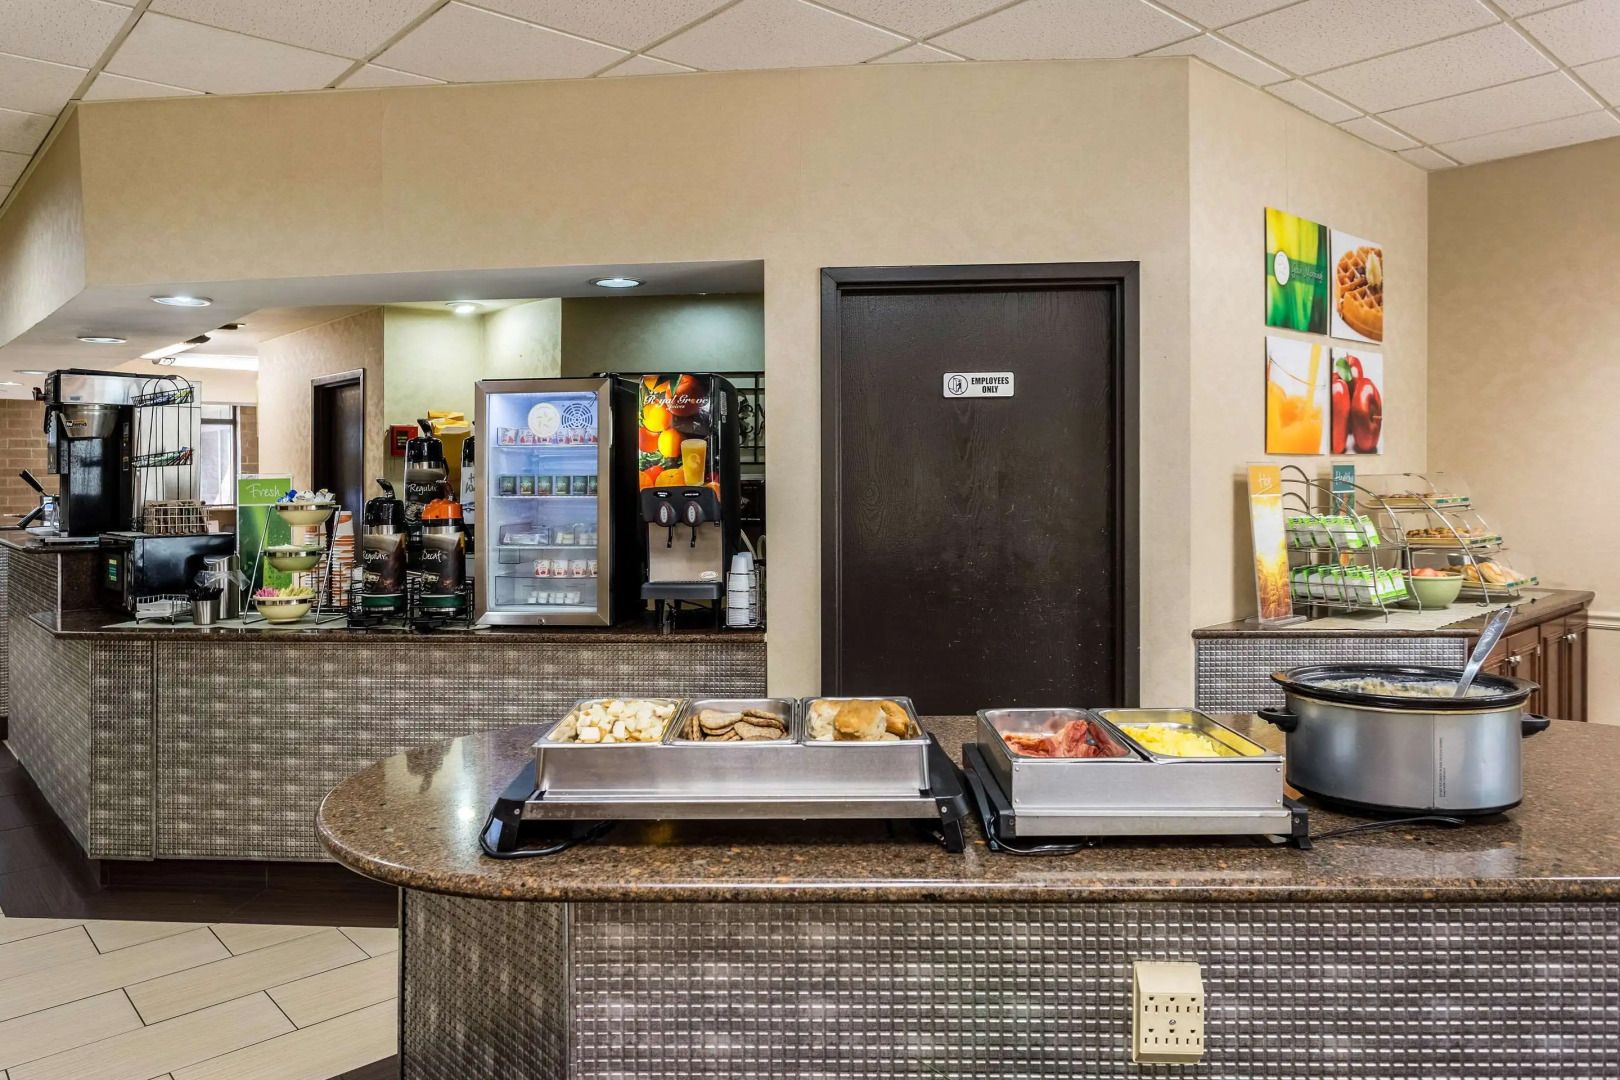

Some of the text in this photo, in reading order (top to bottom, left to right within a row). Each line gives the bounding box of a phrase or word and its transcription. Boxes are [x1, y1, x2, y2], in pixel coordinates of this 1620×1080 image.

[971, 376, 1009, 385] EMPLOYEES
[982, 385, 999, 393] ONLY
[644, 394, 709, 408] Royal Grove
[246, 483, 281, 498] Fresh
[408, 483, 437, 496] Regular
[422, 549, 442, 562] Decaf
